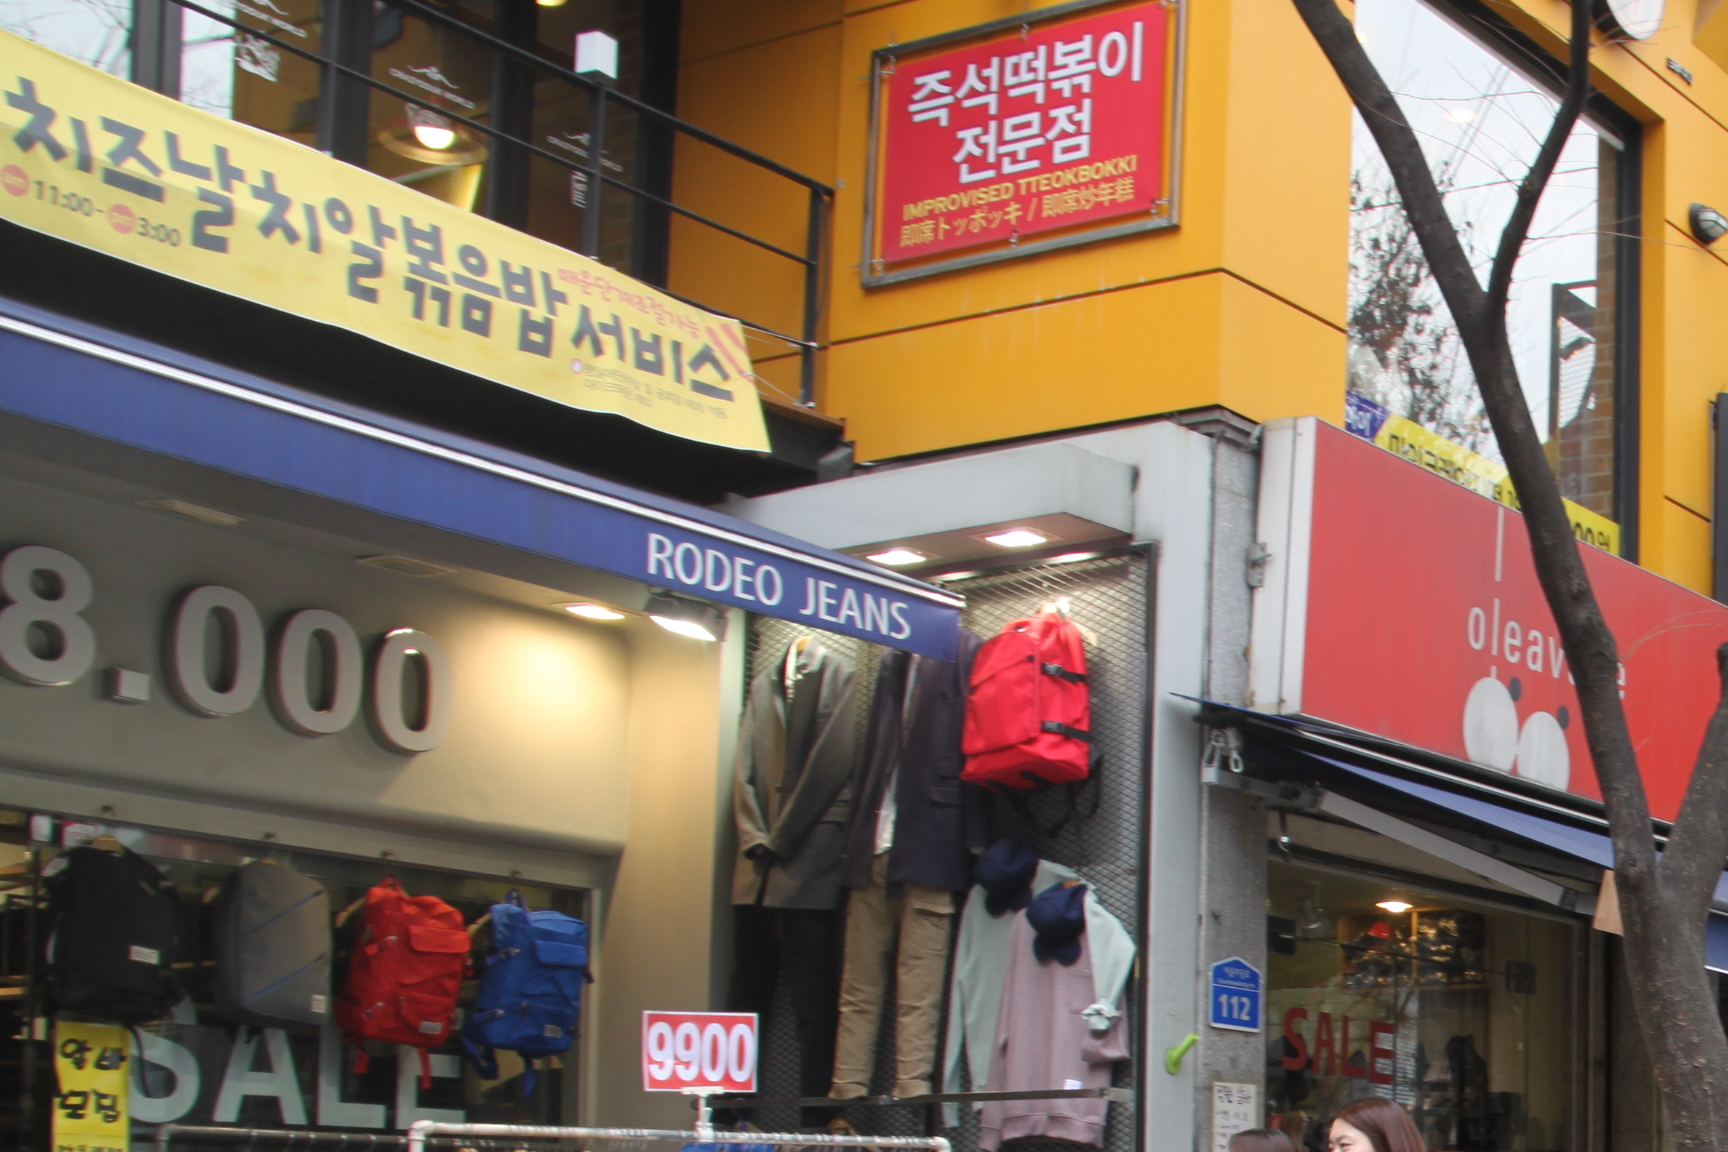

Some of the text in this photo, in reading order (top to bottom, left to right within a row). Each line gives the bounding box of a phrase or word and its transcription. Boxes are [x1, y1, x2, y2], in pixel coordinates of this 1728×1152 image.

[908, 21, 1144, 126] 즉석떡볶이
[953, 98, 1092, 183] 전문점
[903, 155, 1137, 220] IMPROVISED TTEOKBOKKI
[3, 76, 735, 402] 치즈날치알볶음밥 서비스
[647, 533, 912, 640] RODEO JEANS
[1218, 994, 1251, 1021] 112
[1282, 1007, 1394, 1085] SALE
[647, 1021, 753, 1082] 9900
